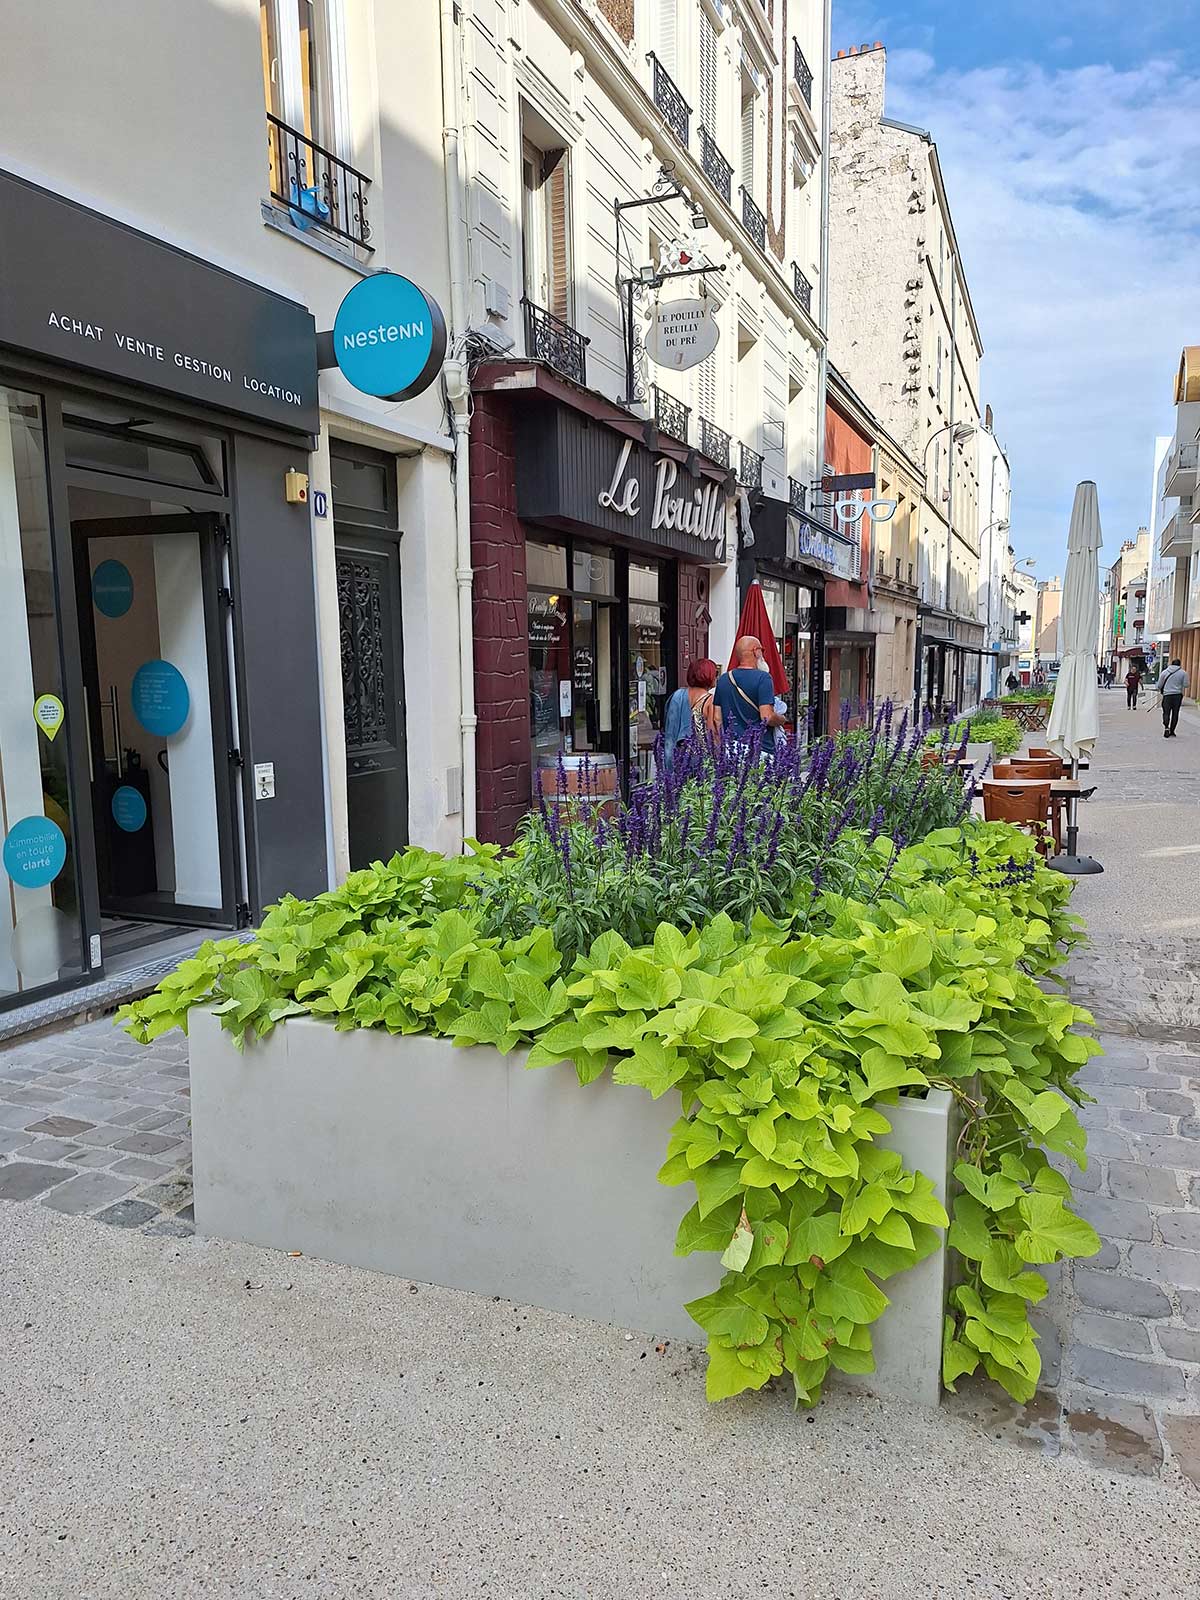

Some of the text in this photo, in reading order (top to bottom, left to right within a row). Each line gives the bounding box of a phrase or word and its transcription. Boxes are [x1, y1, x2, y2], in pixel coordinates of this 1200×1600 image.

[657, 310, 706, 323] LE POUILLY
[663, 323, 699, 335] REUILLY
[666, 338, 678, 347] DU
[48, 312, 301, 406] ACHAT VENTE GESTION LOCATION
[598, 439, 641, 517] Le
[651, 457, 726, 560] Pouilly
[9, 832, 58, 849] L'immobilier
[16, 845, 54, 859] en toute
[22, 856, 51, 871] clarté
